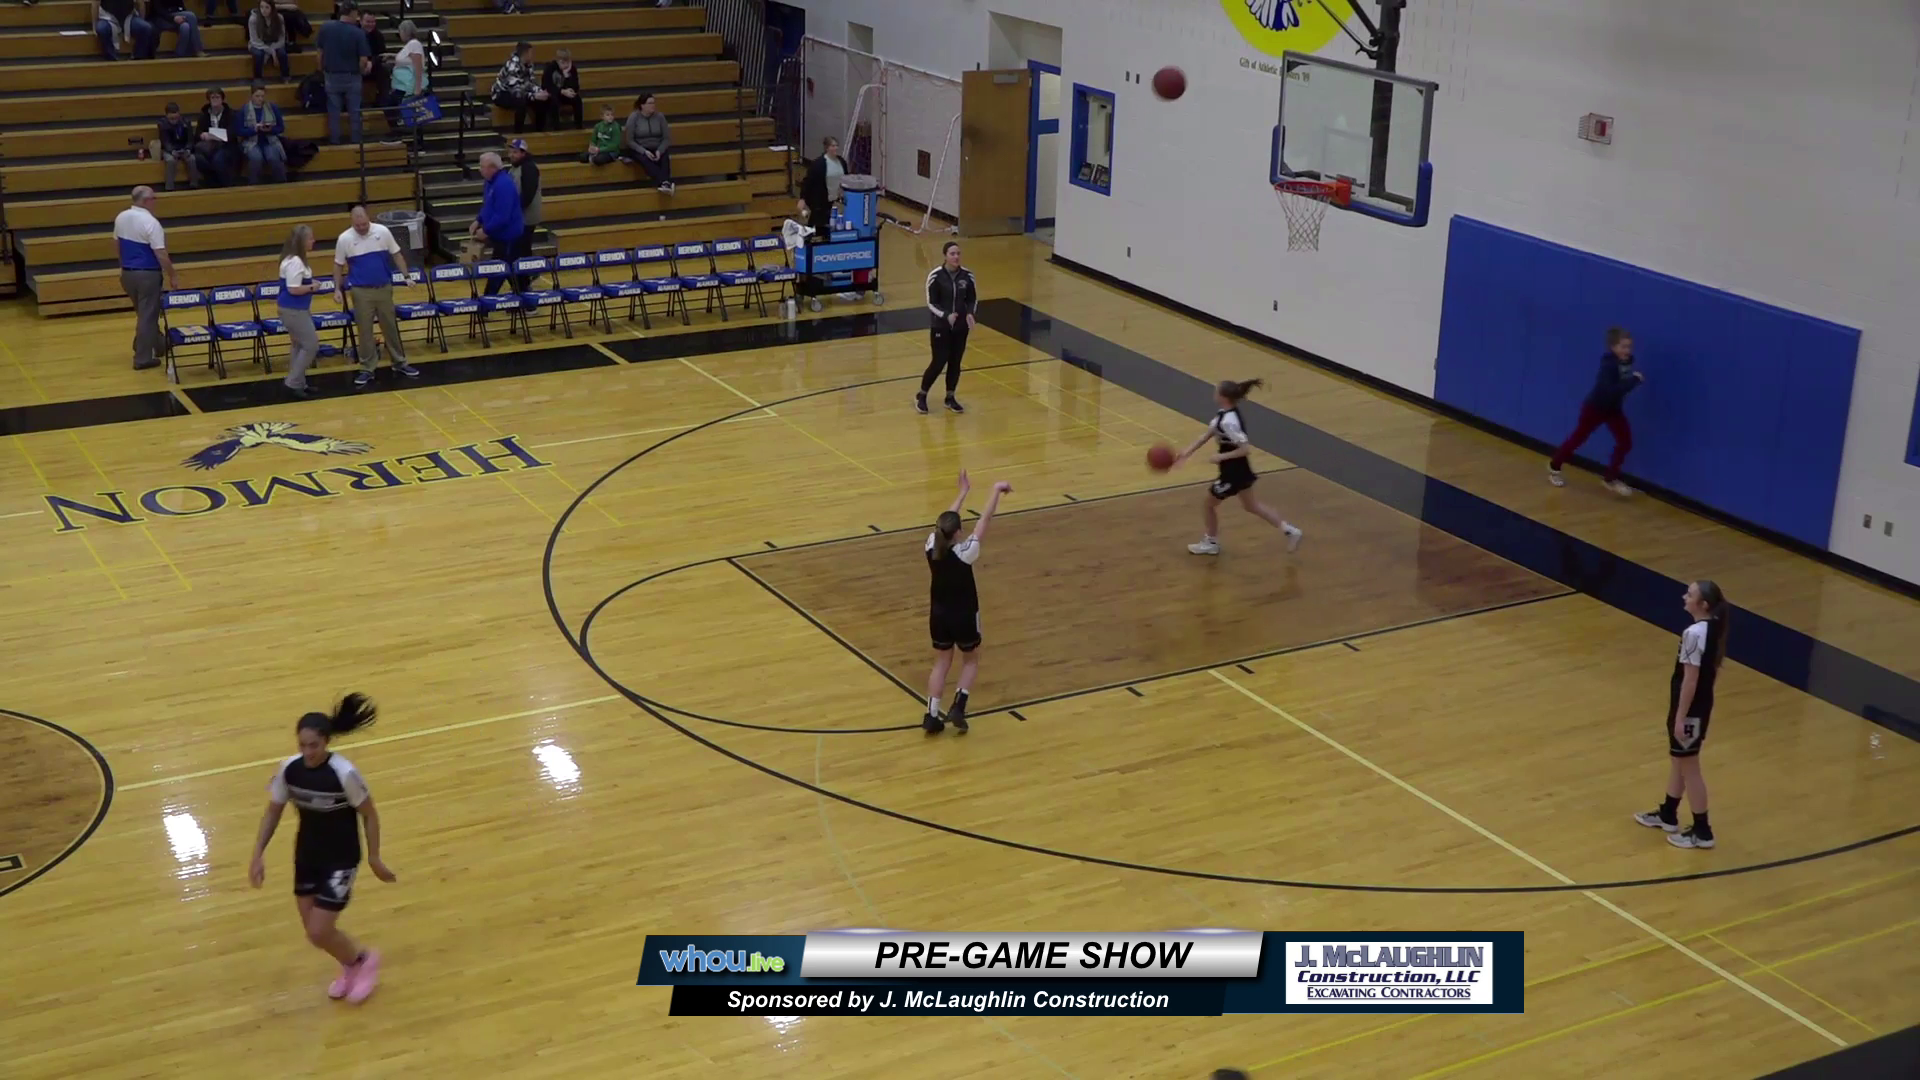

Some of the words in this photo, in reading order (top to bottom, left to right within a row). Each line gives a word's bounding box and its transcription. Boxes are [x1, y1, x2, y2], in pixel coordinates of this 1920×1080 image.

[814, 250, 872, 263] POWERADE
[215, 288, 246, 301] HERMON
[44, 435, 553, 533] HERMON
